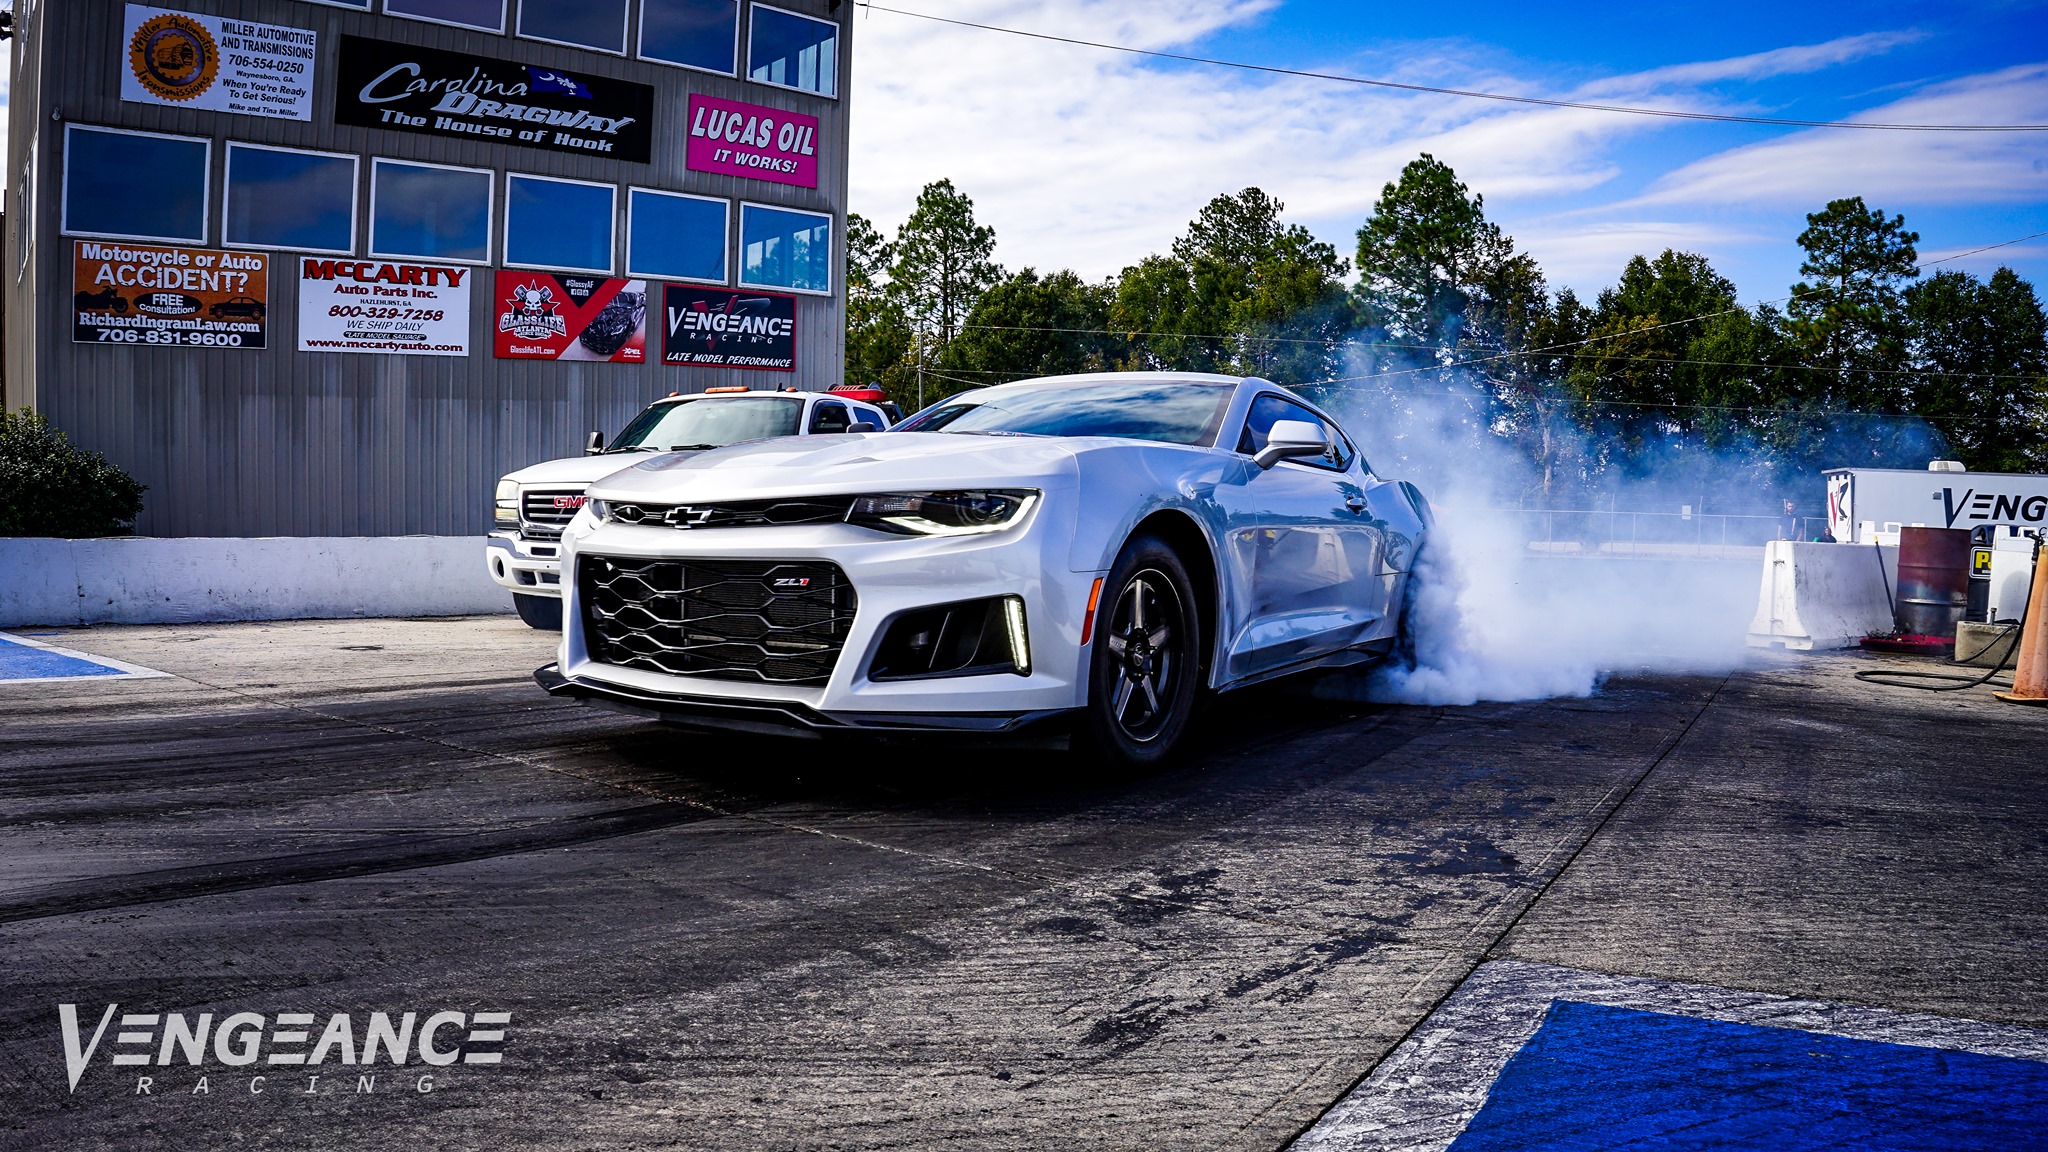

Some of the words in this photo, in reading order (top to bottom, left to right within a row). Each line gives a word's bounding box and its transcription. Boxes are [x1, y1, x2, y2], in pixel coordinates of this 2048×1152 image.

[135, 23, 160, 53] Miller
[167, 18, 212, 62] Automotive
[221, 22, 254, 38] MILLER
[256, 26, 314, 46] AUTOMOTIVE
[221, 36, 240, 49] AND
[242, 39, 313, 60] TRANSMISSIONS
[228, 54, 304, 74] 706-554-0250
[138, 66, 210, 96] Transmissions
[236, 70, 280, 82] Waynesboro,
[359, 62, 528, 103] Carolina
[222, 78, 248, 89] When
[250, 82, 278, 92] You're
[280, 86, 306, 98] Ready
[229, 90, 240, 98] To
[242, 91, 258, 101] Get
[260, 93, 296, 105] Serious!
[262, 106, 277, 114] Tina
[278, 108, 298, 117] Miller
[429, 91, 637, 135] DRAGWAY
[380, 108, 427, 128] The
[434, 116, 512, 138] House
[518, 130, 548, 143] of
[553, 133, 614, 152] Hook
[690, 106, 774, 149] LUCAS
[777, 122, 814, 156] OIL
[713, 148, 732, 163] IT
[734, 151, 798, 174] WORKS!
[82, 243, 190, 267] Motorcycle
[194, 255, 215, 268] or
[218, 253, 263, 271] Auto
[333, 284, 369, 295] Auto
[372, 286, 408, 297] Parts
[412, 288, 438, 299] Inc.
[566, 279, 594, 289] #GlossyAF
[139, 303, 196, 315] Consultation!
[152, 293, 184, 306] FREE
[79, 312, 260, 333] RichardIngramLaw.com
[328, 305, 444, 322] 800-329-7258
[668, 306, 794, 338] VENGEANCE
[347, 320, 364, 330] WE
[366, 321, 394, 330] SHIP
[394, 322, 424, 332] DAILY
[501, 314, 565, 333] GLASSLIFE
[96, 328, 242, 347] 706-831-9600
[306, 339, 463, 352] www.mccartyauto.com
[366, 332, 390, 340] MODEL
[690, 332, 773, 345] RACING
[666, 352, 692, 362] LATE
[692, 353, 724, 364] MODEL
[726, 355, 792, 368] PERFORMANCE
[774, 578, 810, 586] ZL1
